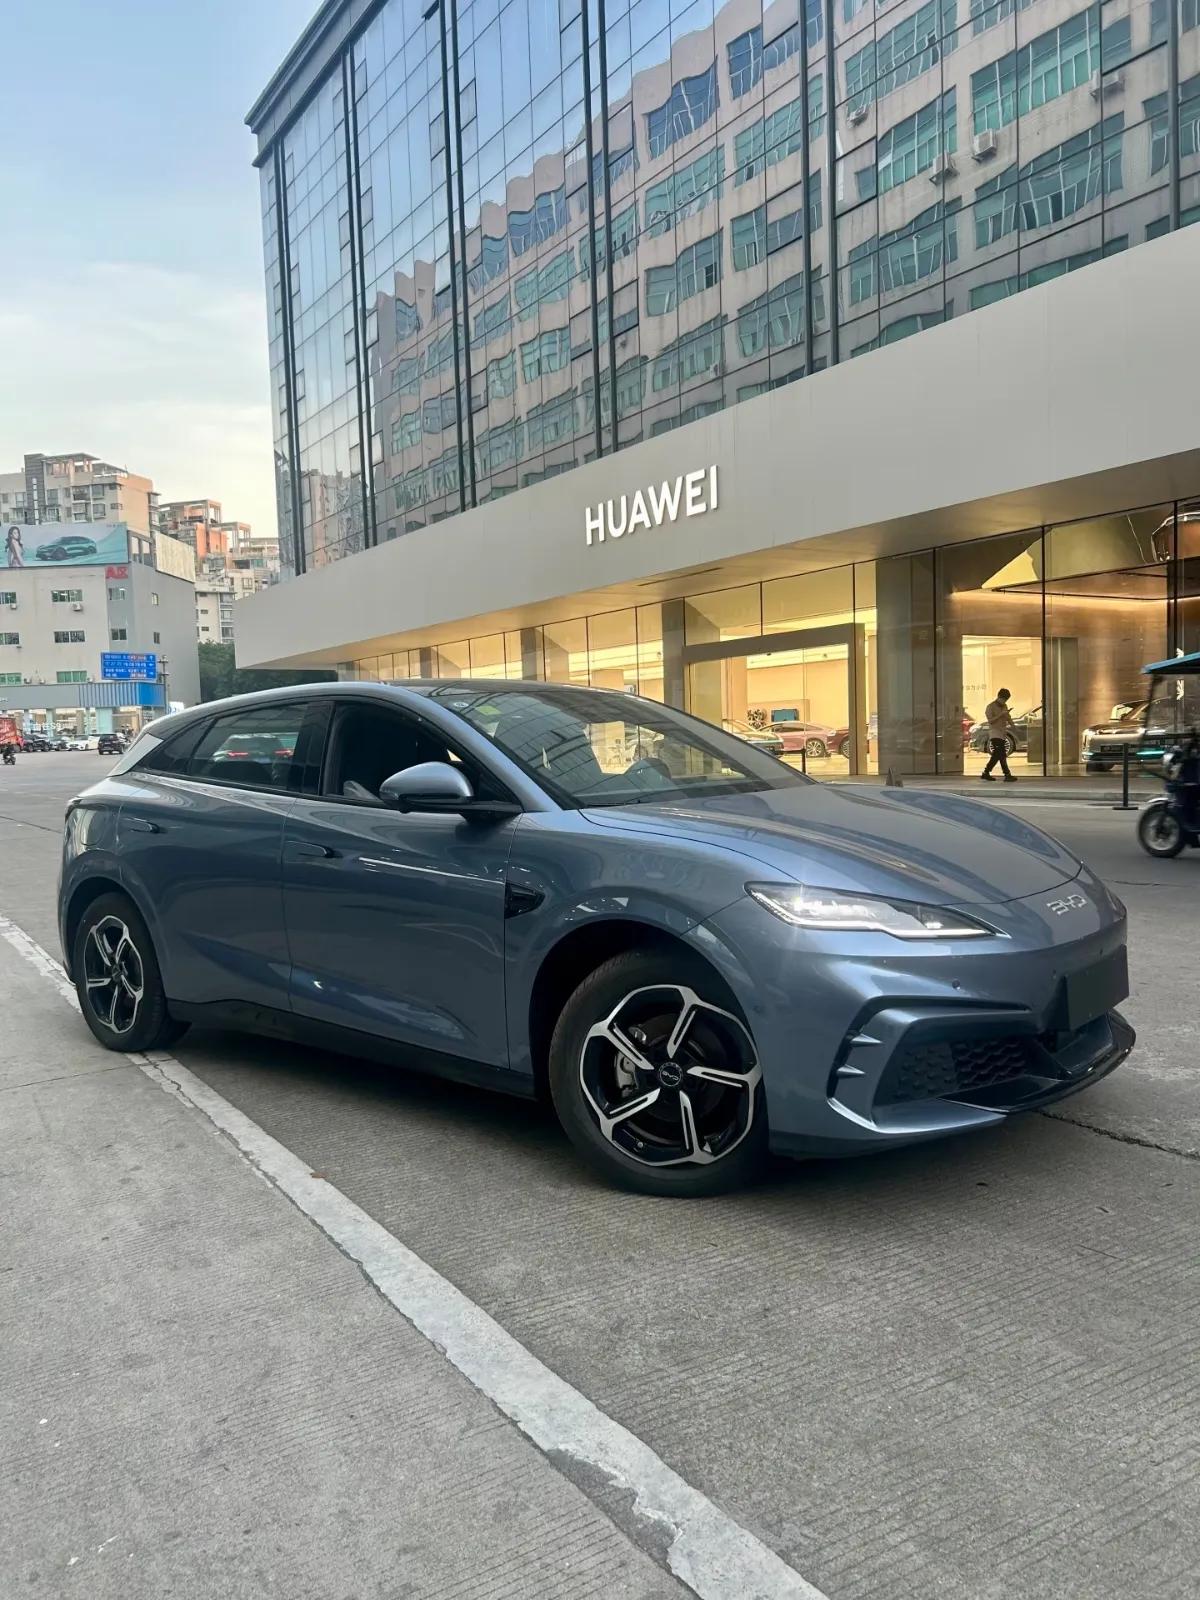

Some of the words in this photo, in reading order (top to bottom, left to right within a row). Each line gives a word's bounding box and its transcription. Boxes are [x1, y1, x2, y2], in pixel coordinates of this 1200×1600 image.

[585, 464, 718, 546] HUAWEI
[1046, 894, 1088, 915] BYD
[662, 1070, 679, 1081] BYD
